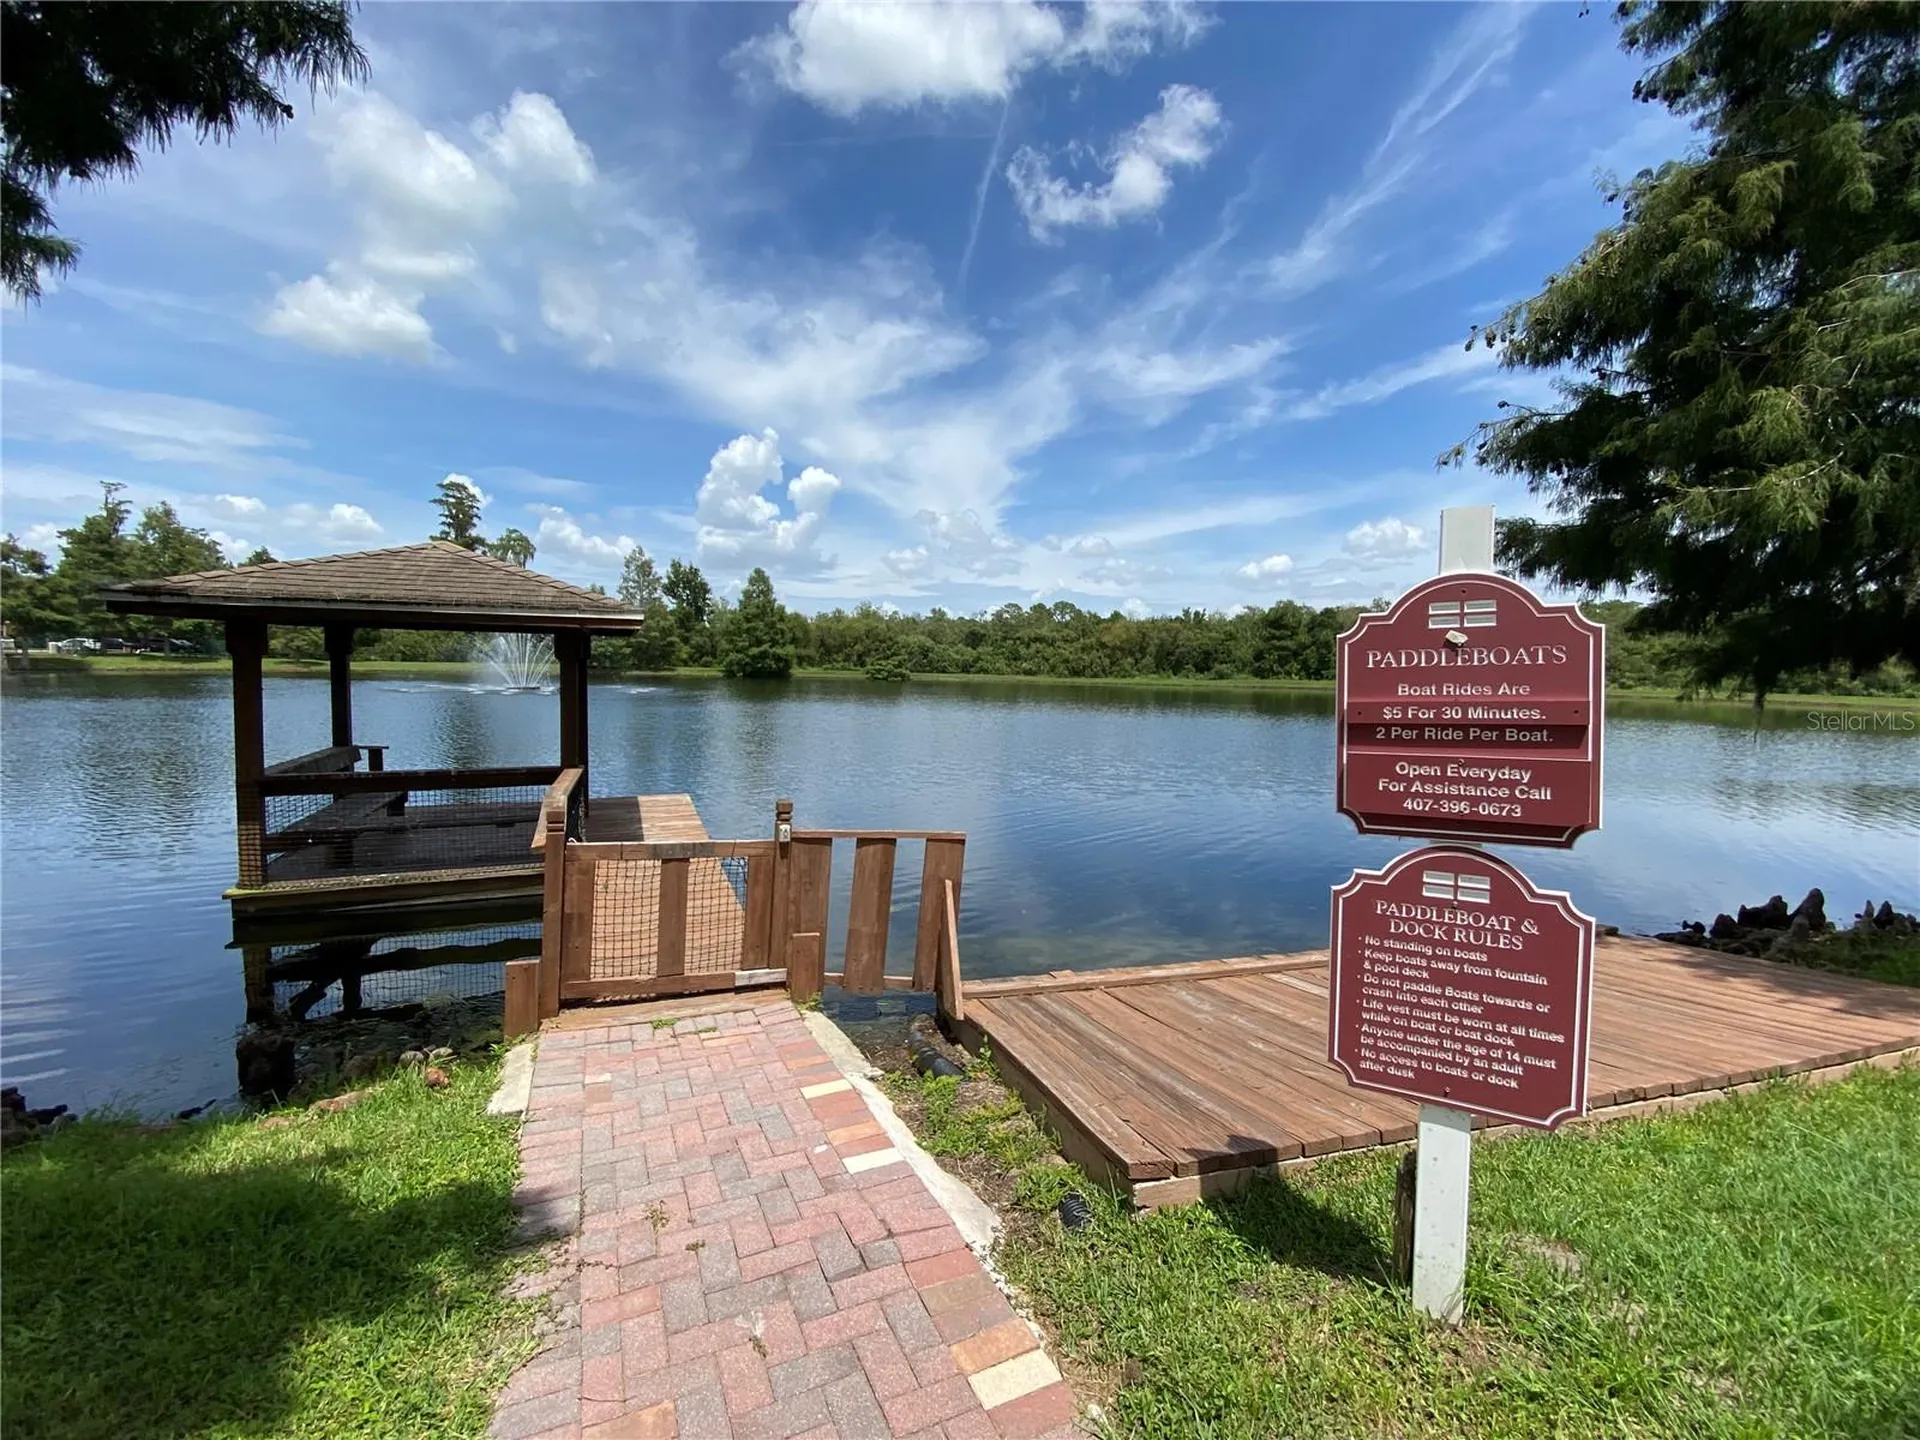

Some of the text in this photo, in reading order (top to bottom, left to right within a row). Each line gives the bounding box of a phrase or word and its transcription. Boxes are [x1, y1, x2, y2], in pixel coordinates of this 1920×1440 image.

[1367, 645, 1567, 668] PADDLEBOATS
[1398, 682, 1530, 696] Boat Rides Are
[1383, 706, 1547, 720] $5 For 30 Minutes.
[1376, 727, 1553, 742] 2 Per Ride Per Boat.
[1396, 762, 1531, 783] Open Everyday
[1379, 779, 1551, 800] For Assistance Call
[1403, 798, 1522, 817] 407-396-0673
[1376, 900, 1540, 935] PADDLEBOAT &
[1365, 935, 1488, 962] No standing on boats
[1390, 920, 1524, 951] DOCK RULES
[1363, 961, 1430, 979] & pool deck
[1365, 949, 1548, 986] Keep boats away from fountain
[1362, 985, 1484, 1015] crash into each other
[1364, 973, 1550, 1013] Do not paddle Boats towards or
[1362, 1010, 1516, 1047] while on boat or boat dock
[1363, 998, 1565, 1043] Life vest must be worn at all times
[1361, 1035, 1524, 1075] be accompanied by an adult
[1362, 1023, 1557, 1069] Anyone under the age of 14 must
[1360, 1059, 1415, 1079] after dusk
[1361, 1048, 1519, 1089] No access to boats or dock
